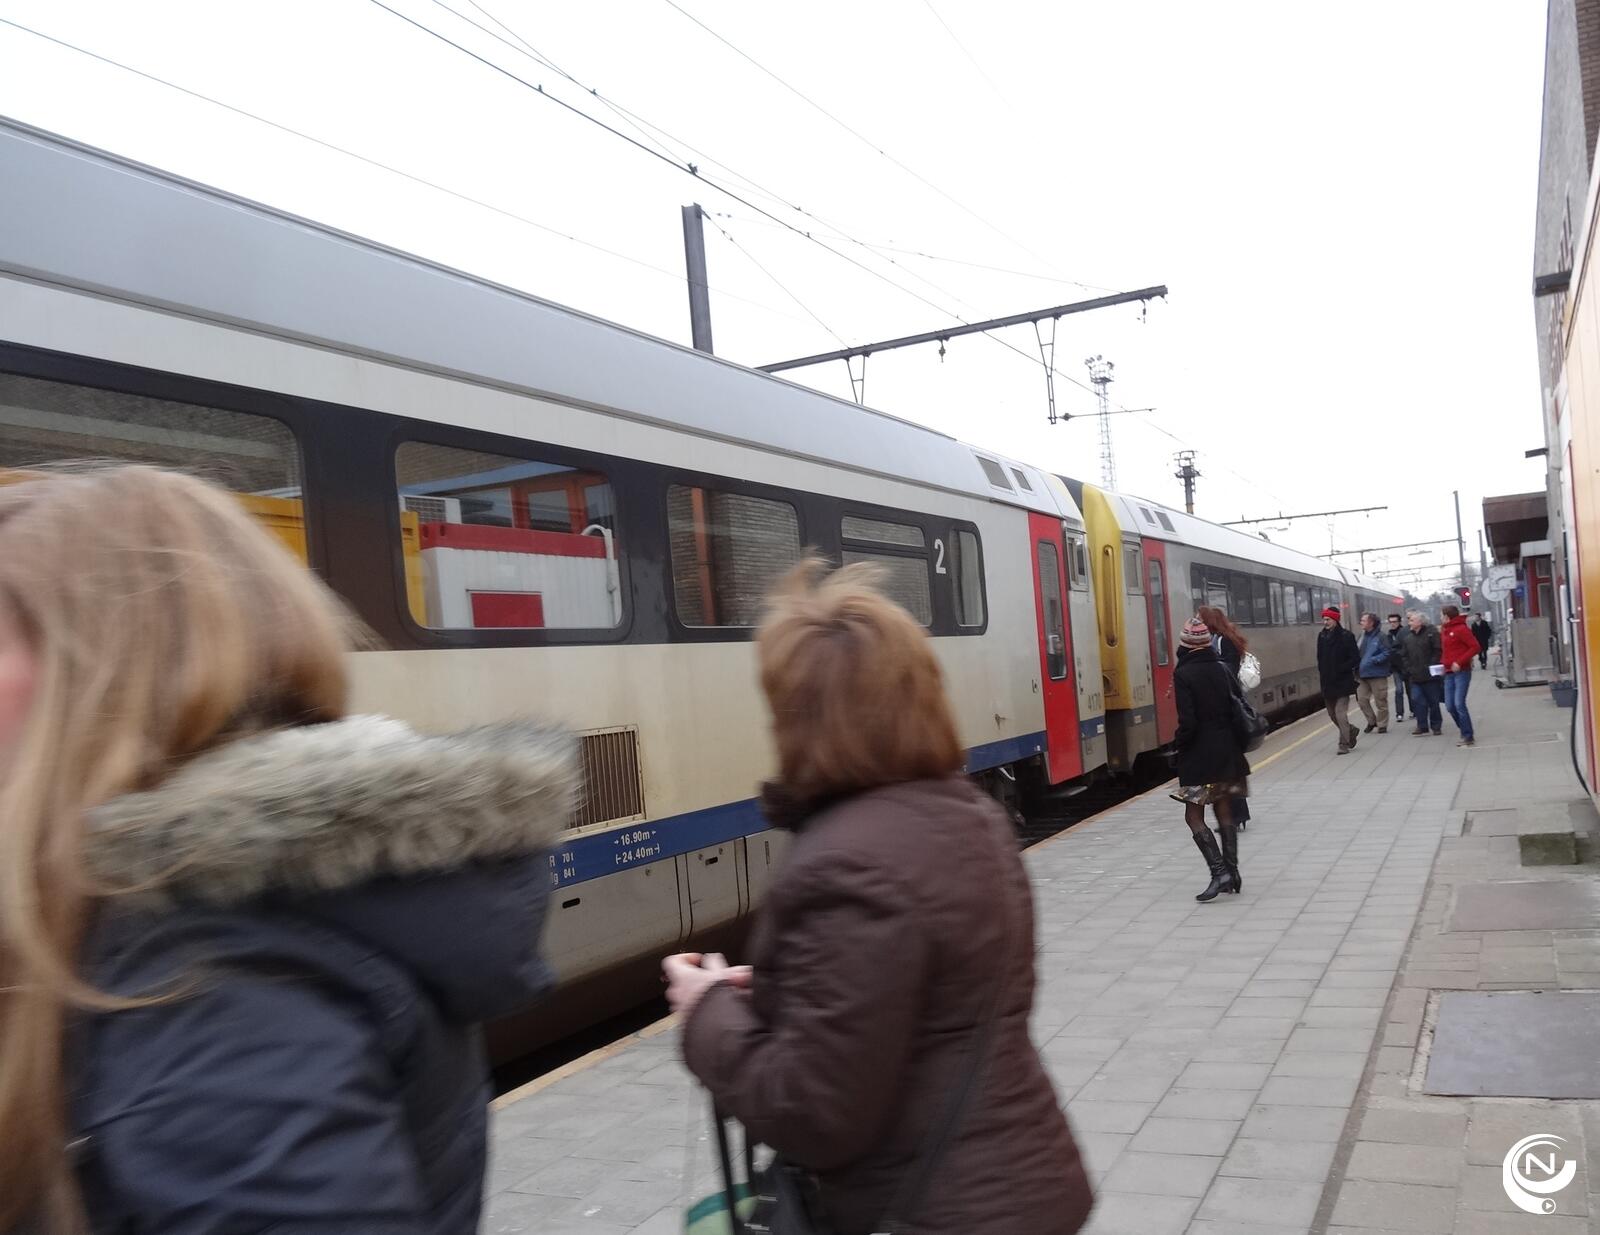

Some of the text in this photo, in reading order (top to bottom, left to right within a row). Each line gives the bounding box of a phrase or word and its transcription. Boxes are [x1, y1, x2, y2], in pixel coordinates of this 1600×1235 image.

[934, 538, 947, 575] 2
[620, 831, 651, 847] 16.90m
[622, 846, 654, 864] 24.40m
